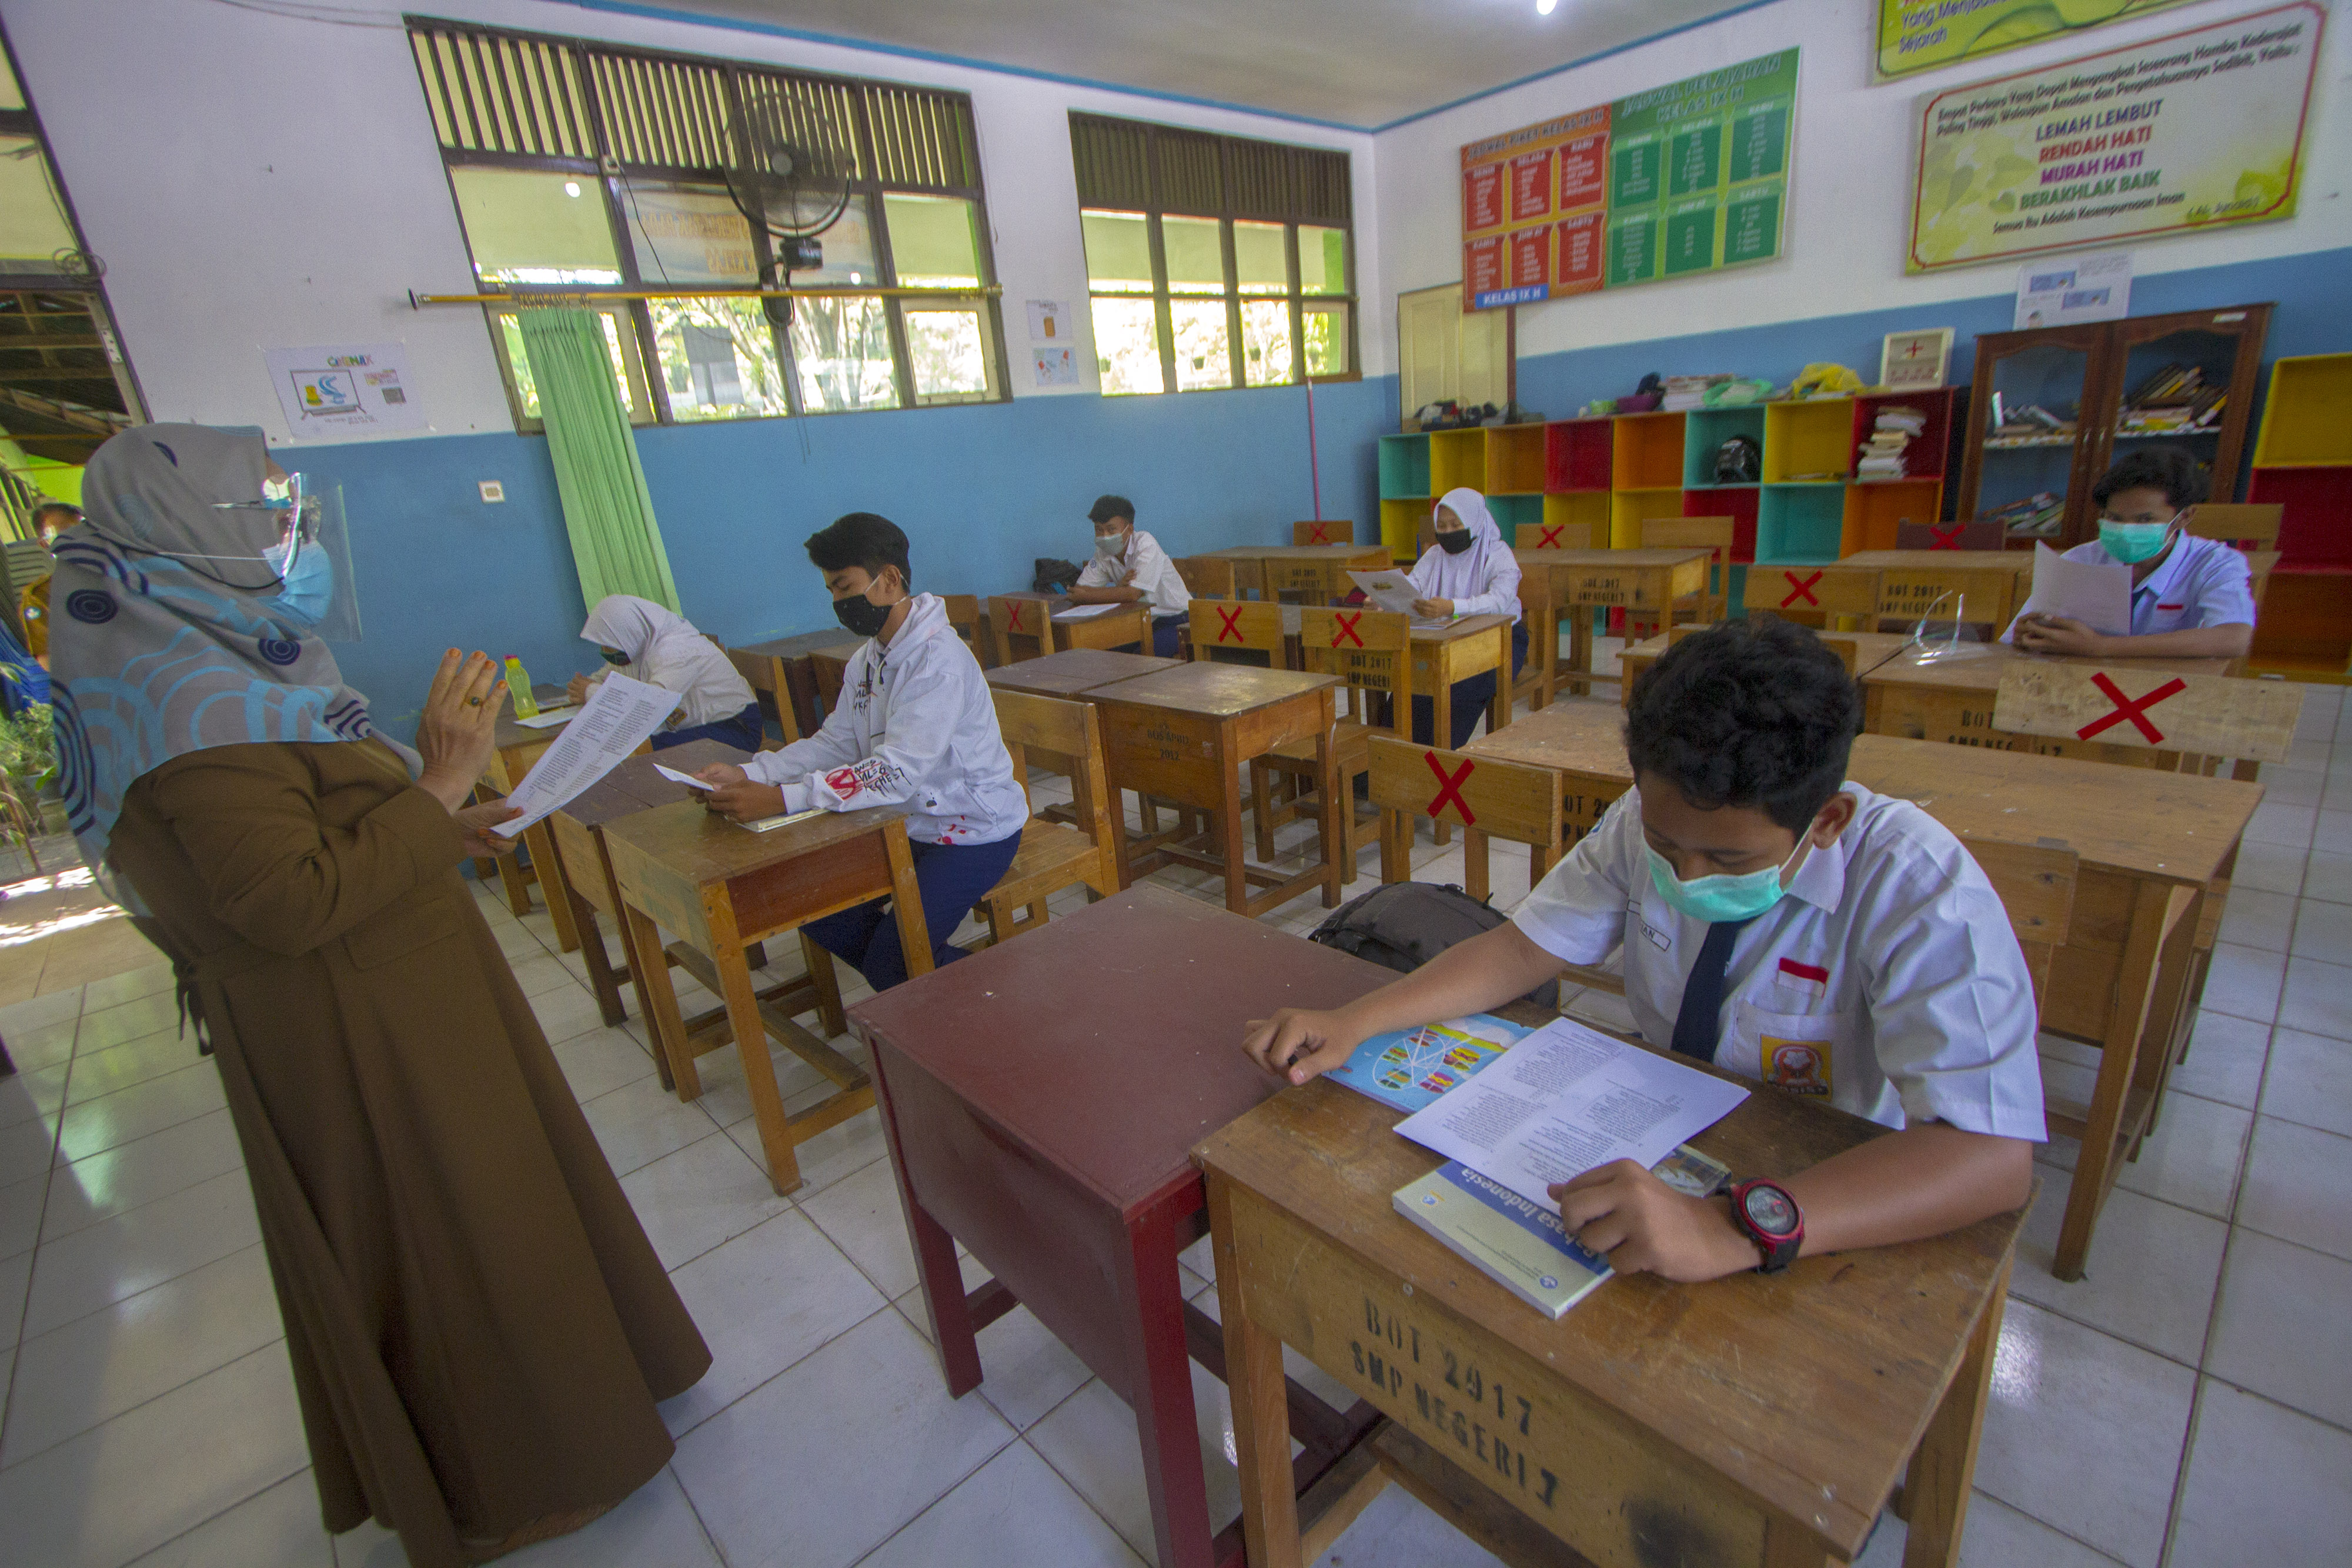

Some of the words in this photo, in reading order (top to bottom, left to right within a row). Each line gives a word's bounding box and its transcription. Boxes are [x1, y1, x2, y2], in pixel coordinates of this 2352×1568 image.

[1902, 9, 1935, 29] Yang
[1899, 26, 1947, 55] Sejarah
[1622, 84, 1682, 119] JADWAL
[1685, 55, 1782, 97] PELAJARAN
[1467, 138, 1506, 162] JADWAL
[1509, 128, 1539, 146] PIKET
[1541, 118, 1578, 138] KELAS
[2036, 114, 2093, 142] LEMAH
[2095, 98, 2164, 129] LEMBUT
[2039, 133, 2109, 164] RENDAH
[2110, 123, 2153, 148] HATI
[2040, 158, 2100, 186] MURAH
[2102, 149, 2145, 173] HATI
[2019, 176, 2117, 211] BERAKHLAK
[2119, 169, 2162, 193] BAIK
[1484, 290, 1518, 305] KELAS
[1519, 288, 1530, 302] IX
[1532, 286, 1541, 297] H
[1914, 584, 1942, 597] 2017
[1362, 673, 1390, 688] NEGERI
[1371, 657, 1391, 670] 2017
[1461, 1168, 1538, 1217] Indonesia
[1365, 1297, 1420, 1363] BOT
[1441, 1345, 1532, 1436] 2017
[1352, 1340, 1403, 1398] SMP
[1414, 1382, 1526, 1489] NEGERI
